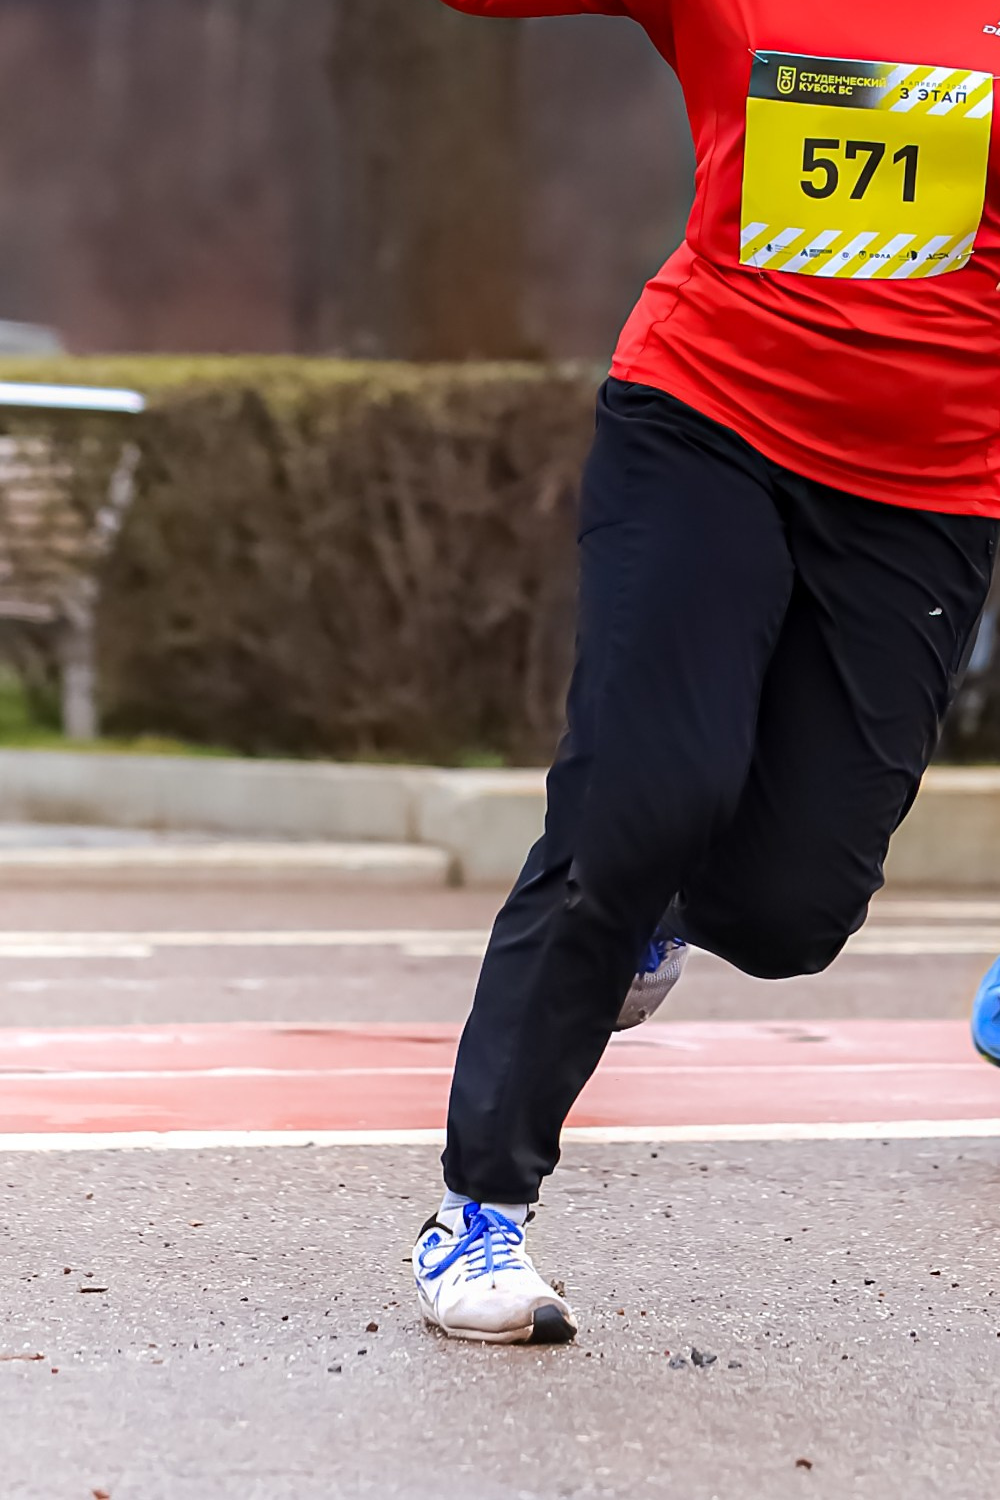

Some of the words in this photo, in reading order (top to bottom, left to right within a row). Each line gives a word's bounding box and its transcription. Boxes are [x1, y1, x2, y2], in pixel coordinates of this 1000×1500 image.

[780, 70, 793, 90] СК
[798, 81, 837, 94] КУБОК
[838, 86, 853, 95] БС
[799, 71, 888, 88] СТУДЕНЧЕСКИЙ
[908, 80, 943, 88] АПРЕЛЯ
[899, 87, 910, 99] 3
[917, 88, 967, 104] ЭТАП
[800, 137, 920, 203] 571
